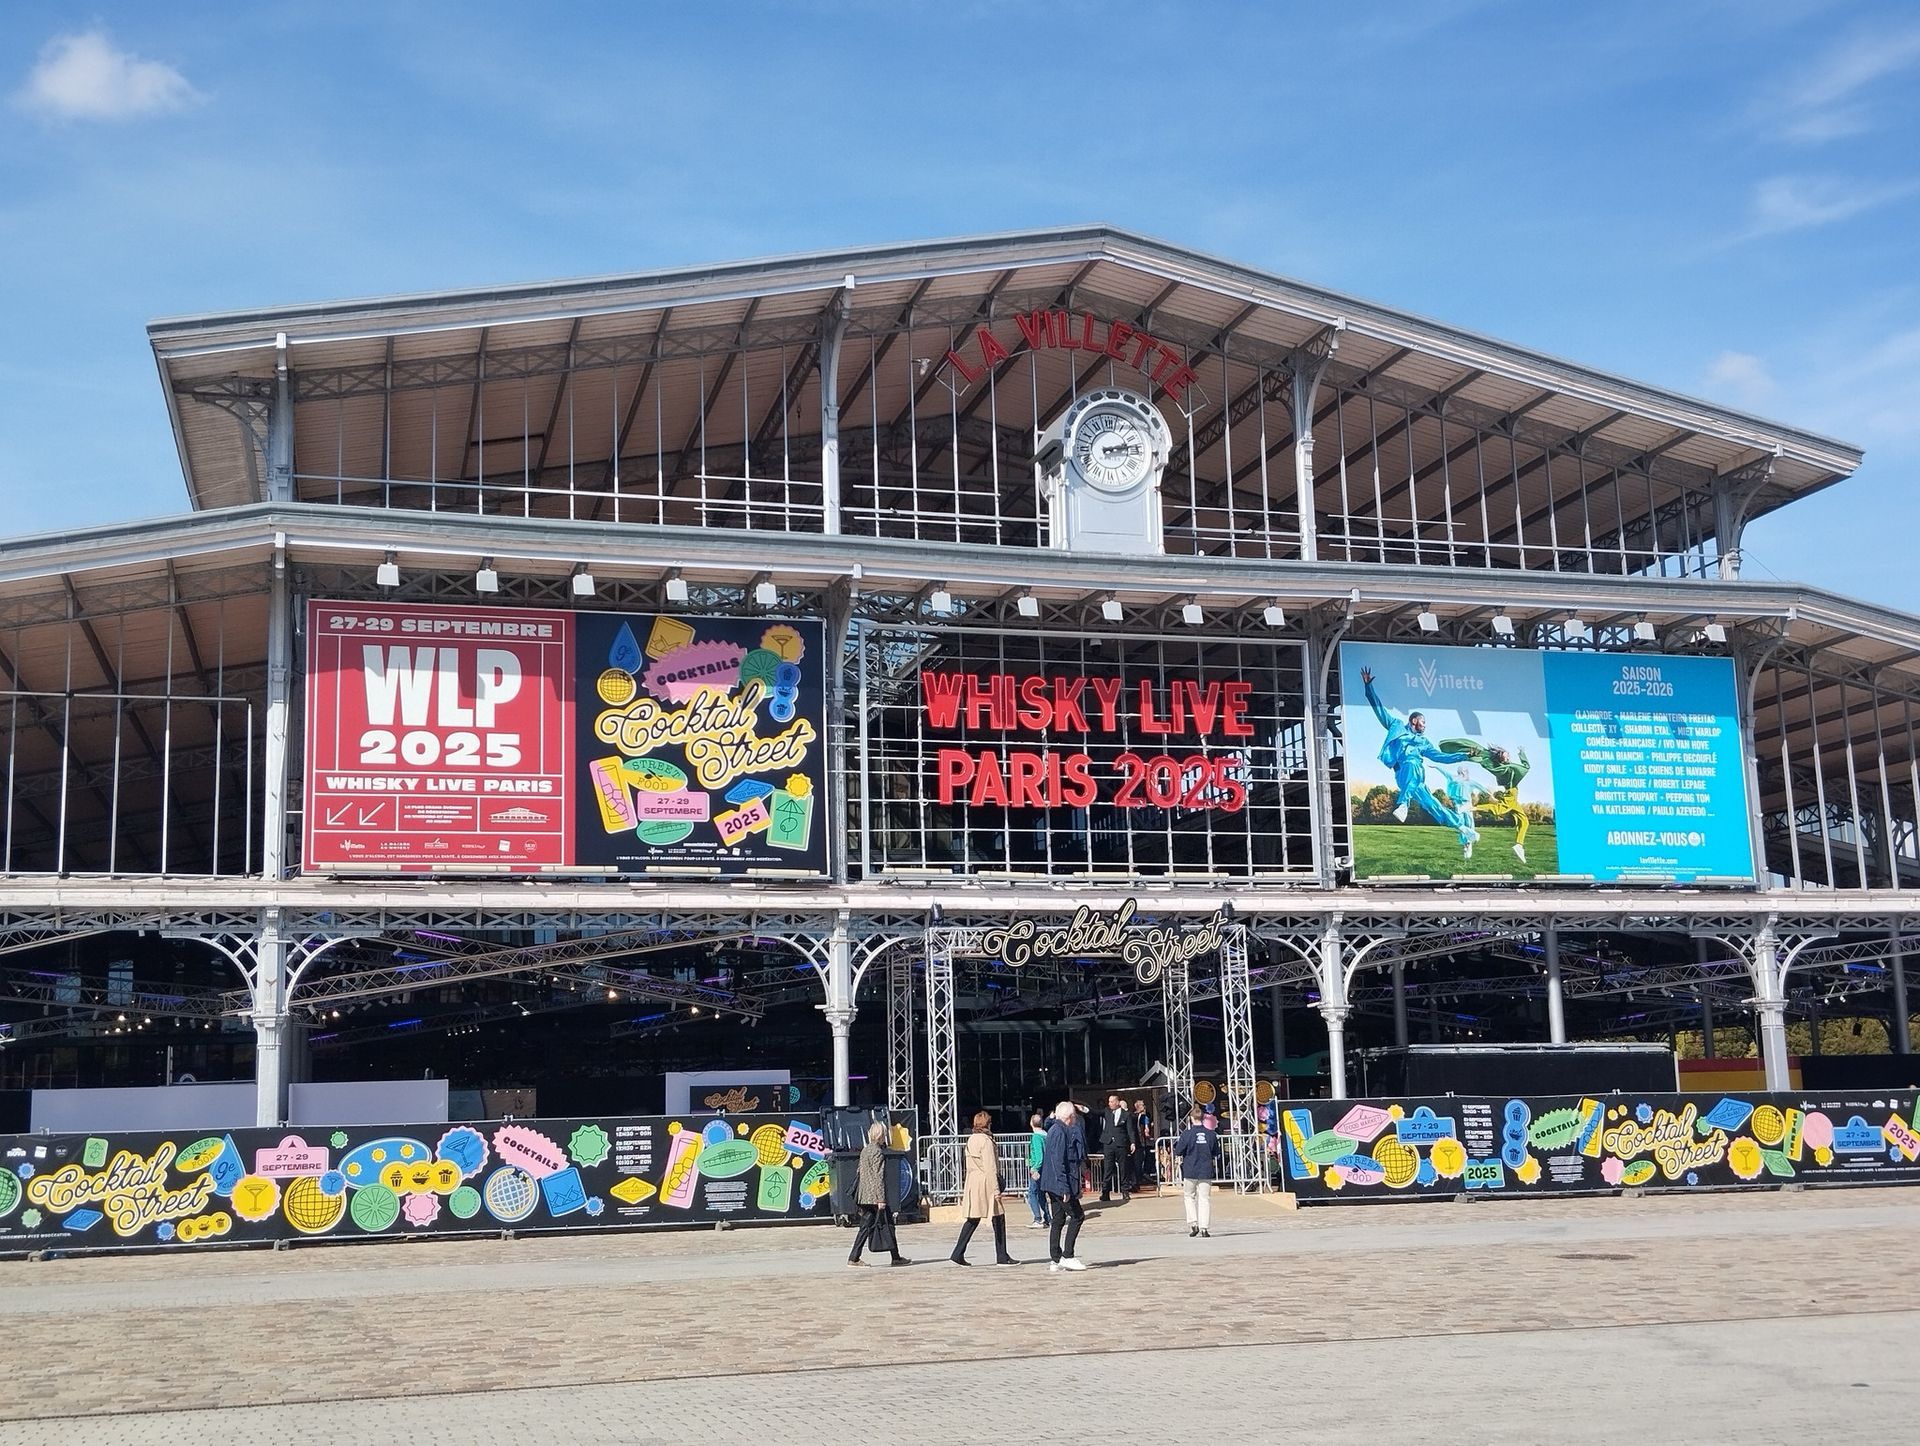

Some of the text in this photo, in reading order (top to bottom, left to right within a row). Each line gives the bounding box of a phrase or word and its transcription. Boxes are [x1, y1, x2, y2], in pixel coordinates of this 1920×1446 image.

[948, 310, 1200, 401] LA VILLETTE
[330, 616, 553, 638] 27-29 SEPTEMBRE
[657, 657, 740, 686] COCKTAILS
[1622, 666, 1662, 683] SAISON
[363, 645, 523, 728] WLP
[1613, 680, 1674, 697] 2025-2026
[600, 683, 759, 749] Cocktail
[922, 672, 1255, 736] WHISKY LIVE
[359, 730, 522, 767] 2025
[691, 723, 809, 781] Street
[632, 760, 681, 777] STREET
[326, 776, 553, 793] WHISKY LIVE PARIS
[637, 777, 669, 790] FOOD
[938, 750, 1246, 813] PARIS 2025
[644, 807, 703, 815] SEPTEMBRE
[725, 808, 760, 835] 2025
[983, 898, 1136, 967] Cocktail
[1123, 911, 1228, 984] Street
[1535, 1118, 1580, 1139] COCKTAILS
[1605, 1106, 1692, 1154] Cocktail
[1889, 1124, 1917, 1149] 2025
[181, 1139, 218, 1161] STREET
[791, 1131, 825, 1151] 2025
[192, 1152, 215, 1168] FOOD
[296, 1153, 309, 1161] 29
[503, 1136, 559, 1171] COCKTAILS
[1342, 1156, 1381, 1170] STREET
[1658, 1134, 1723, 1174] Street
[32, 1145, 170, 1207] Cocktail
[262, 1163, 322, 1171] SEPTEMBRE
[804, 1161, 828, 1185] STRE
[1347, 1171, 1372, 1181] FOOD
[1468, 1167, 1497, 1179] 2025
[109, 1177, 213, 1230] Street
